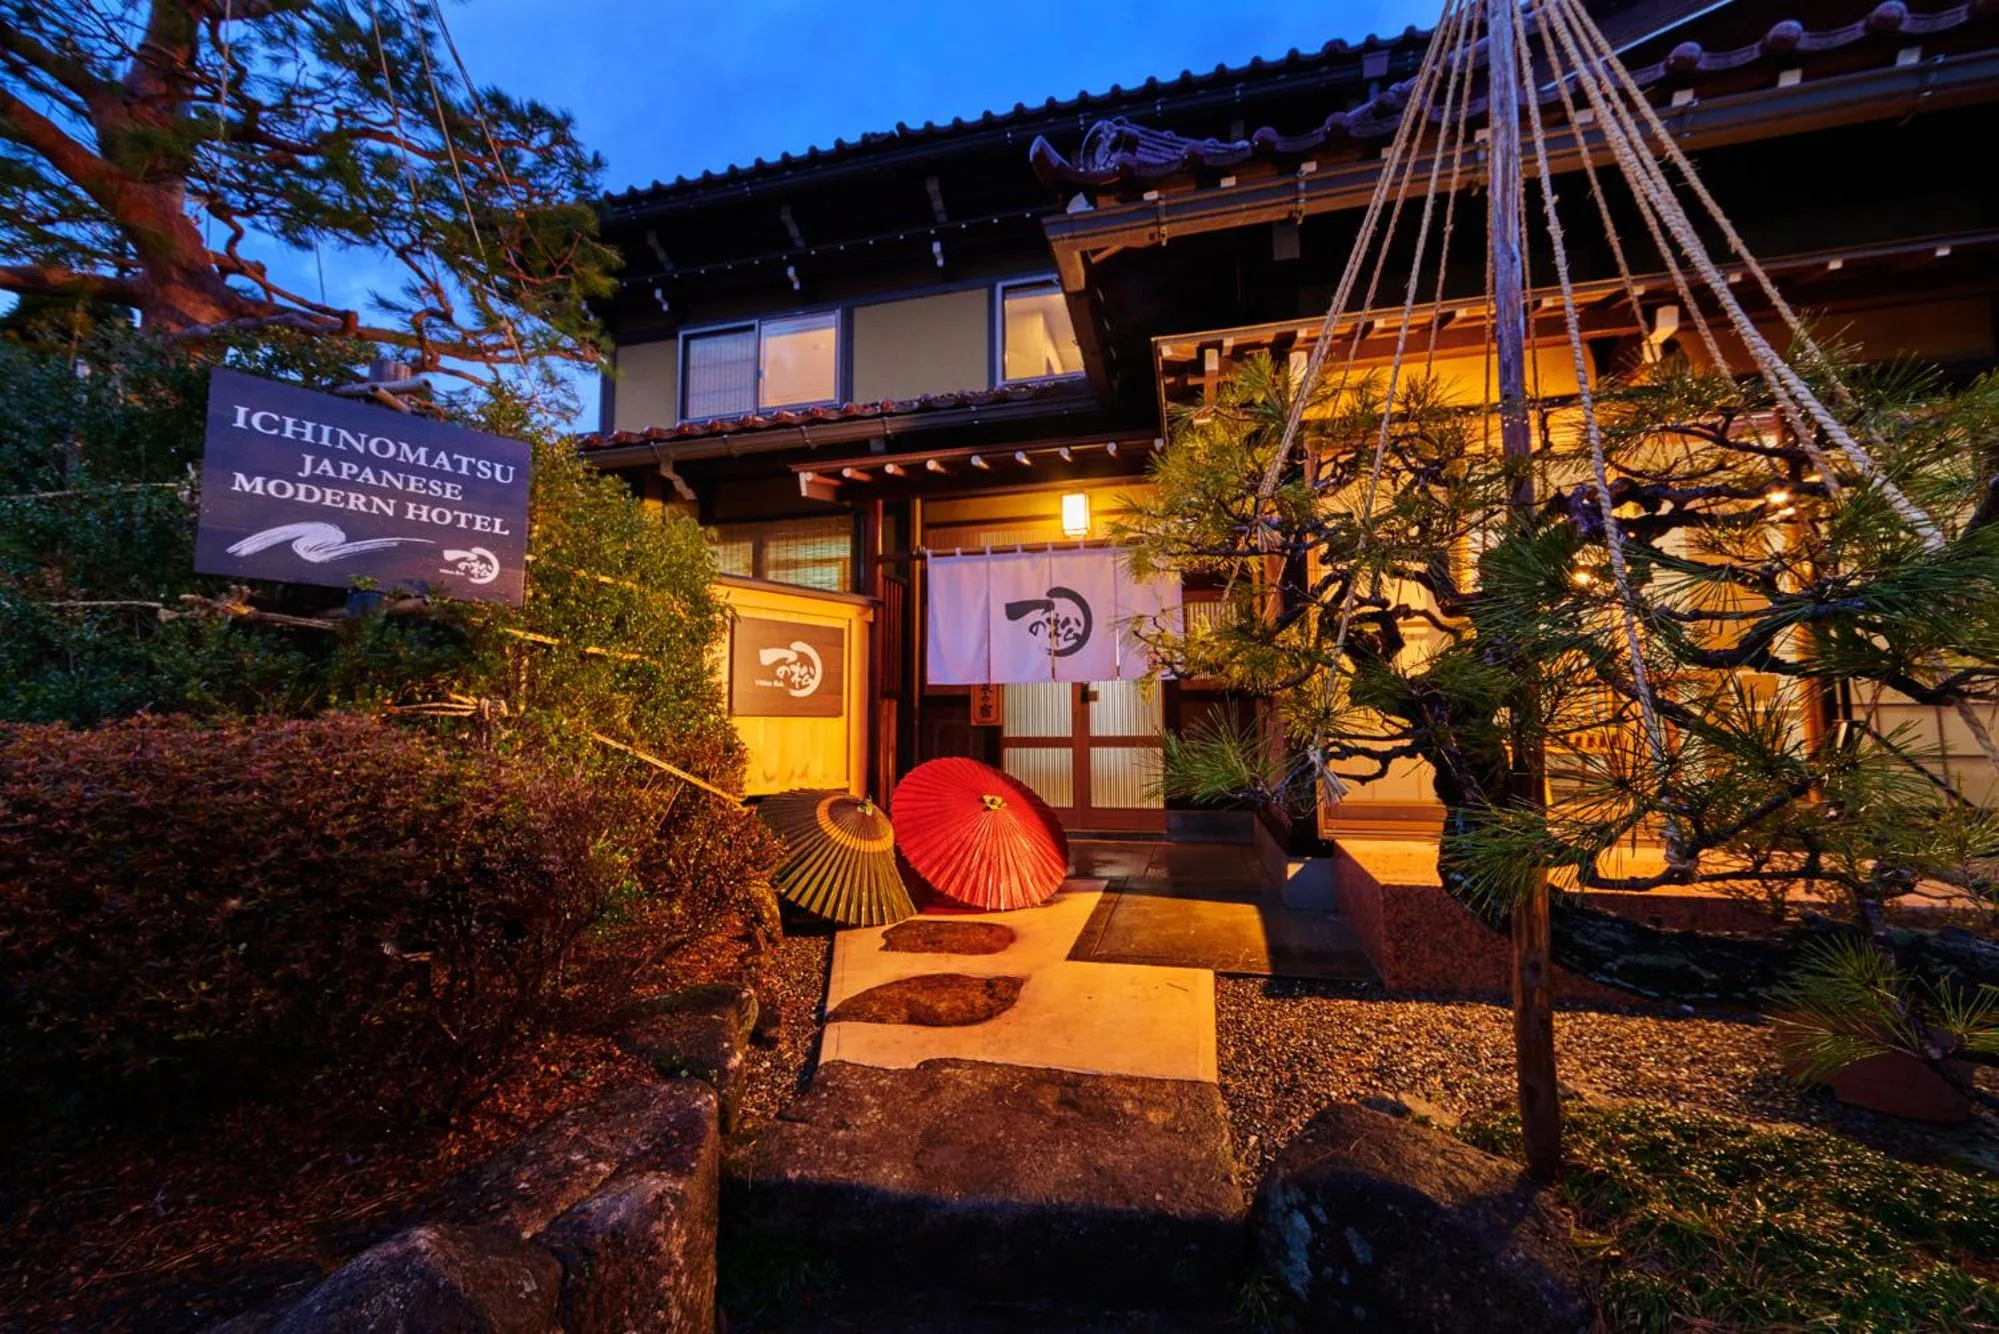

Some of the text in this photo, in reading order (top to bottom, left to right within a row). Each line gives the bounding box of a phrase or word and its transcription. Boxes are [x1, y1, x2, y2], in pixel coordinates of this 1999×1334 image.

[231, 404, 516, 484] ICHINOMATSU
[230, 472, 510, 536] MODERN HOTEL
[298, 454, 463, 501] JAPANESE
